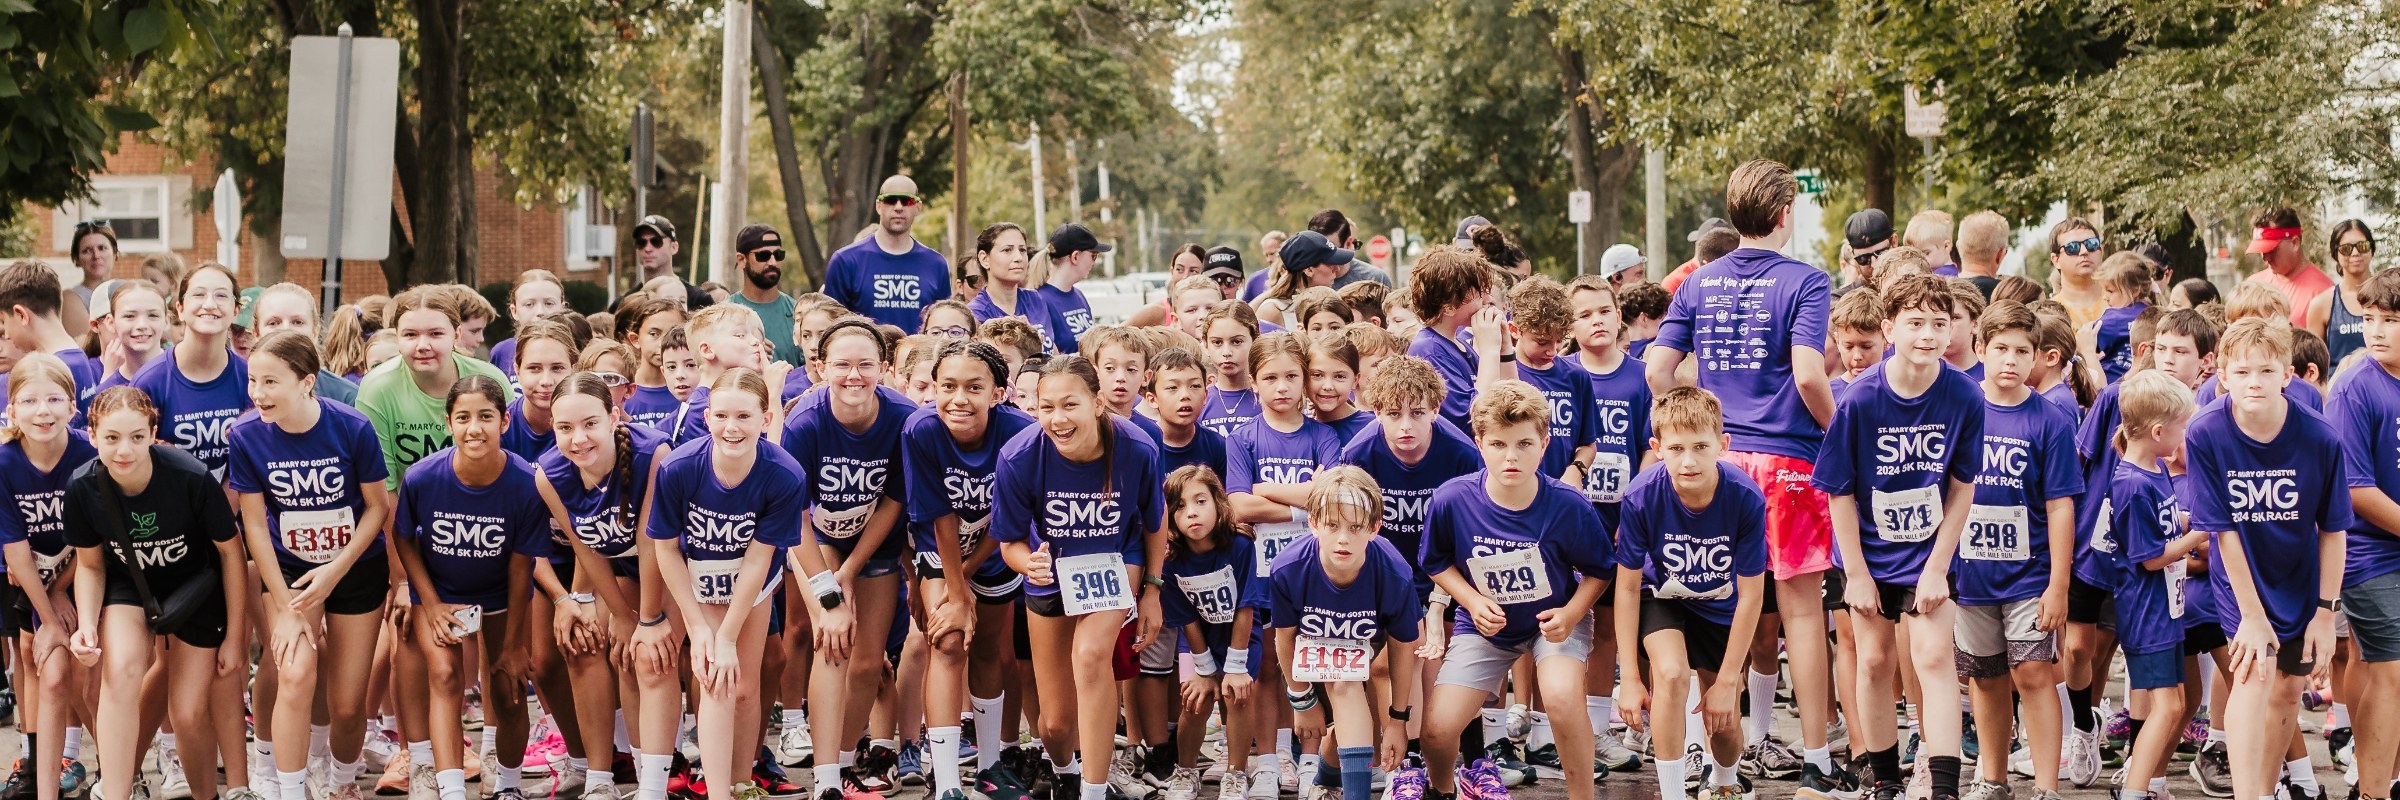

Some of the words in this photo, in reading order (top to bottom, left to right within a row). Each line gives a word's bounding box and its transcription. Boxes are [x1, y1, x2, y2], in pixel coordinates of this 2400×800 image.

[874, 280, 921, 300] SMG
[1700, 276, 1722, 287] Thank
[1724, 277, 1738, 290] You
[1739, 278, 1777, 290] Sponsors!
[900, 300, 920, 308] RACE
[1066, 312, 1093, 334] SMG
[184, 412, 204, 420] MARY
[214, 408, 240, 416] GOSTYN
[396, 422, 407, 430] ST.
[409, 422, 434, 431] MARY
[1553, 428, 1572, 436] RACE
[1603, 436, 1627, 445] RACE
[1876, 432, 1946, 463] SMG
[2003, 437, 2030, 448] GOSTYN
[198, 450, 210, 460] 5K
[278, 460, 300, 468] MARY
[310, 456, 340, 467] GOSTYN
[860, 458, 889, 467] GOSTYN
[1876, 466, 1900, 475] 2024
[1902, 462, 1914, 472] 5K
[1916, 462, 1944, 472] RACE
[268, 466, 344, 496] SMG
[818, 464, 888, 492] SMG
[1984, 476, 1998, 486] 5K
[2000, 476, 2024, 489] RACE
[300, 498, 315, 506] 5K
[316, 490, 344, 506] RACE
[842, 494, 856, 502] 5K
[2228, 478, 2299, 510] SMG
[584, 514, 602, 524] MARY
[602, 508, 610, 516] OF
[688, 502, 697, 510] ST.
[698, 506, 718, 518] MARY
[728, 512, 756, 521] GOSTYN
[1046, 500, 1120, 526] SMG
[1884, 504, 1932, 531] 371
[2252, 512, 2266, 522] 5K
[2266, 511, 2299, 522] RACE
[41, 522, 55, 532] 5K
[686, 510, 756, 544] SMG
[823, 513, 868, 532] 329
[1402, 524, 1416, 532] 5K
[287, 525, 352, 552] 1336
[432, 520, 506, 548] SMG
[1046, 528, 1070, 538] 2024
[1072, 528, 1086, 538] 5K
[1089, 526, 1120, 538] RACE
[1970, 522, 2018, 548] 298
[154, 534, 185, 546] GOSTYN
[1484, 538, 1504, 546] MARY
[1702, 536, 1730, 544] GOSTYN
[432, 543, 454, 556] 2024
[457, 548, 471, 558] 5K
[474, 547, 502, 558] RACE
[708, 544, 724, 552] 5K
[1662, 542, 1732, 572] SMG
[1486, 566, 1536, 594] 429
[1688, 574, 1702, 582] 5K
[1703, 571, 1731, 582] RACE
[699, 573, 739, 597] 39
[1072, 569, 1120, 600] 396
[1082, 603, 1094, 611] ONE
[1187, 586, 1234, 614] 259
[1315, 608, 1336, 616] MARY
[1300, 614, 1376, 639] SMG
[1298, 646, 1366, 668] 1162
